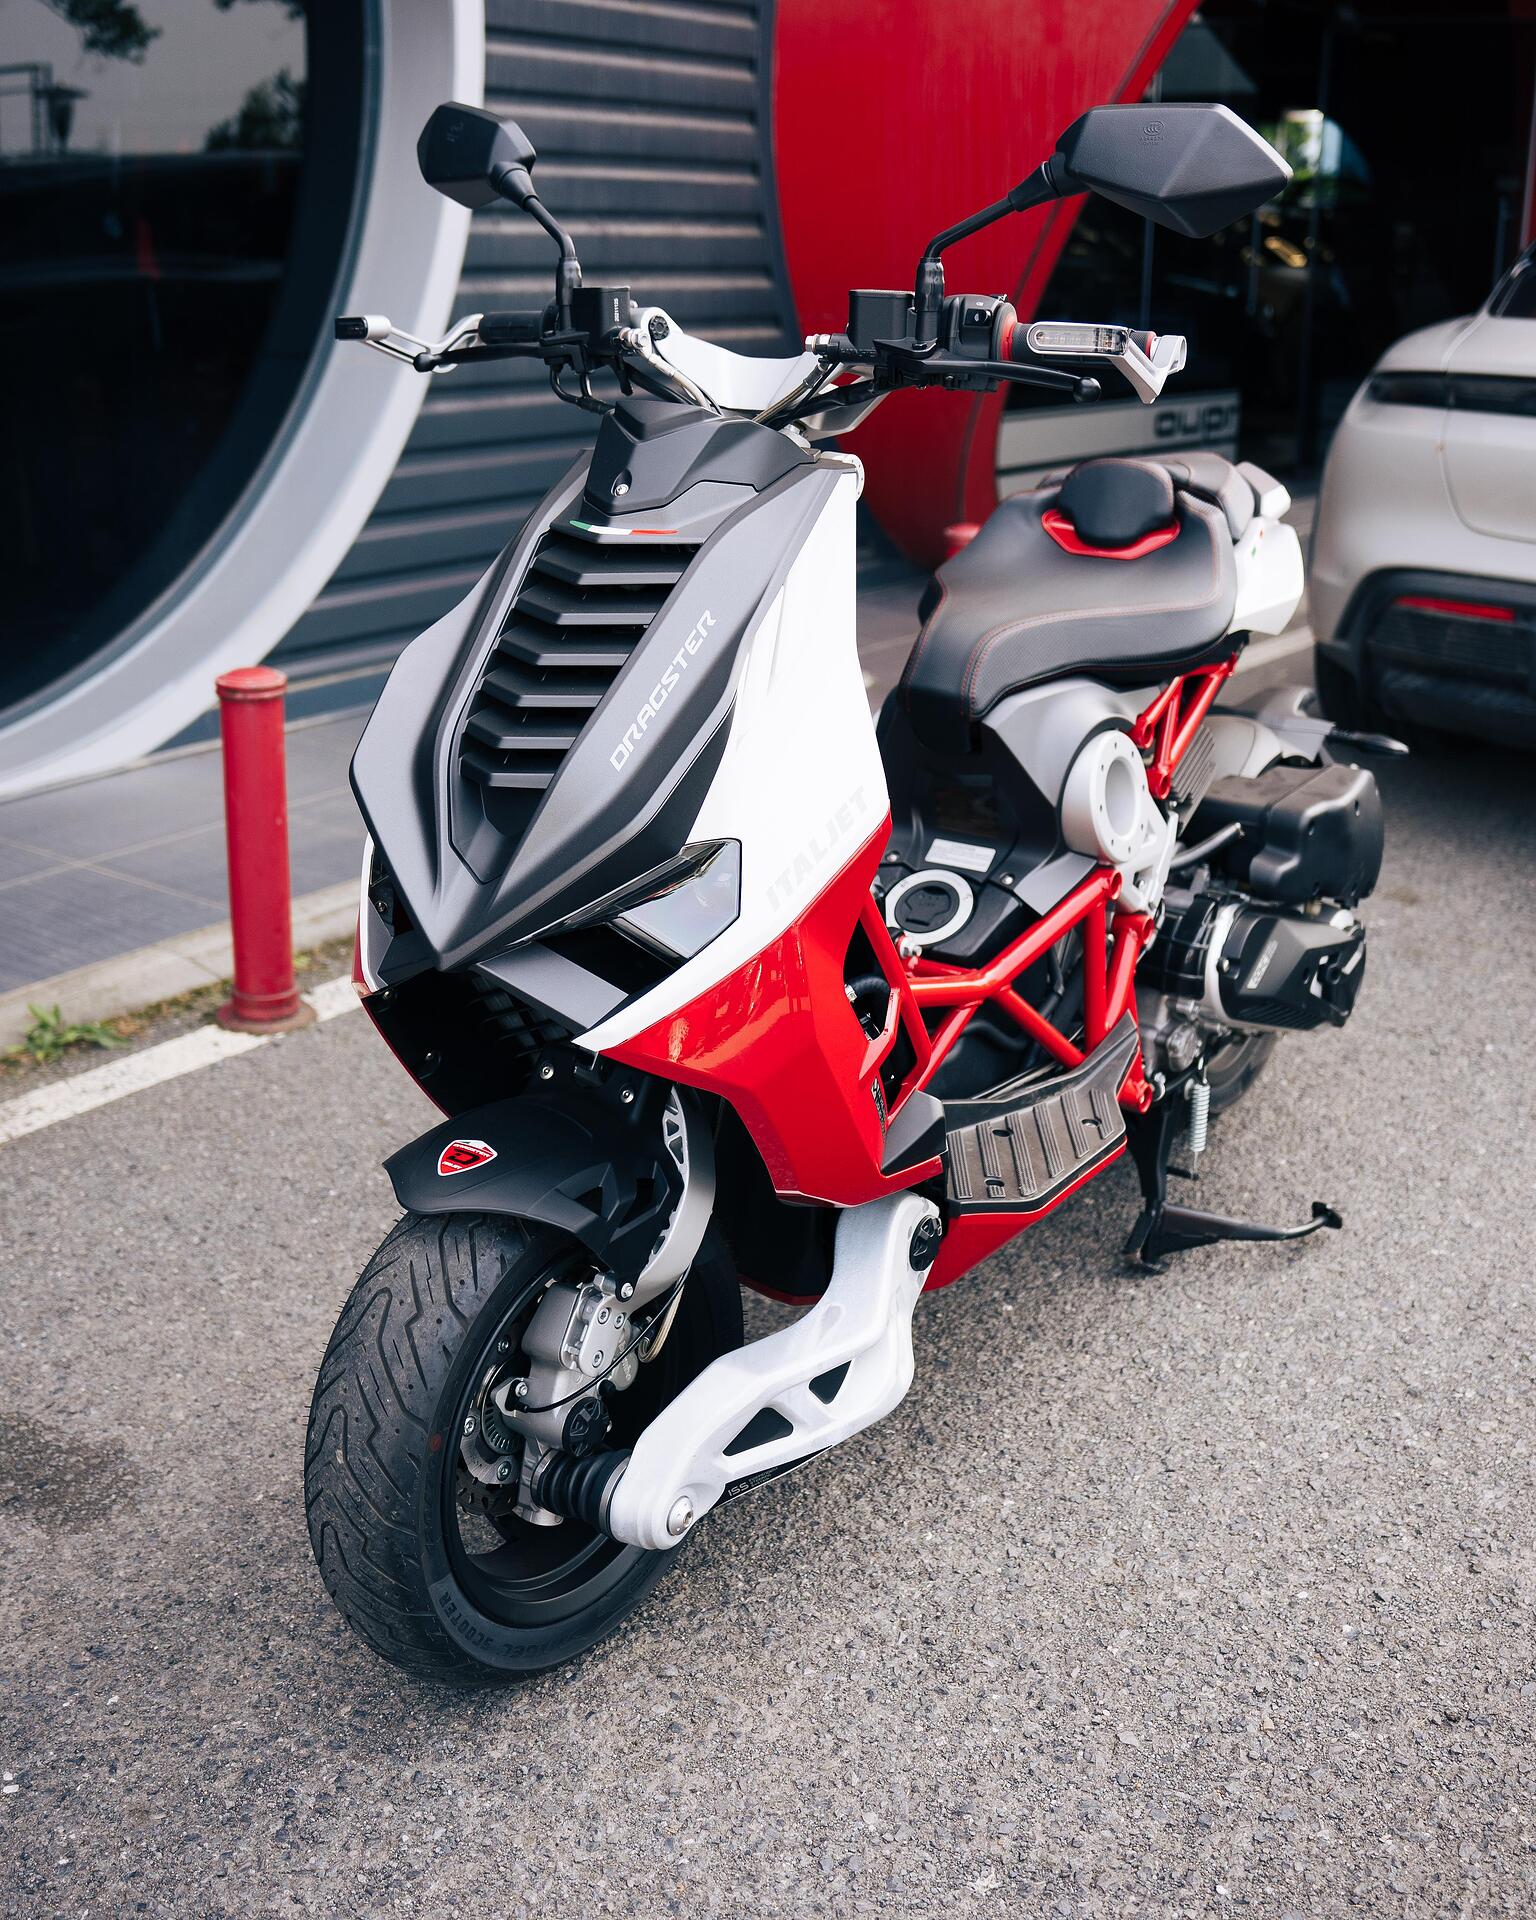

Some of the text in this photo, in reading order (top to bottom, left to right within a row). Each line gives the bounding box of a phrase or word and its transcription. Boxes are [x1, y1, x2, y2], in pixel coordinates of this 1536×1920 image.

[609, 609, 718, 773] DRAGSTER
[765, 784, 868, 913] ITALJET
[727, 1481, 750, 1497] ISS
[438, 1591, 494, 1649] SCOOTER
